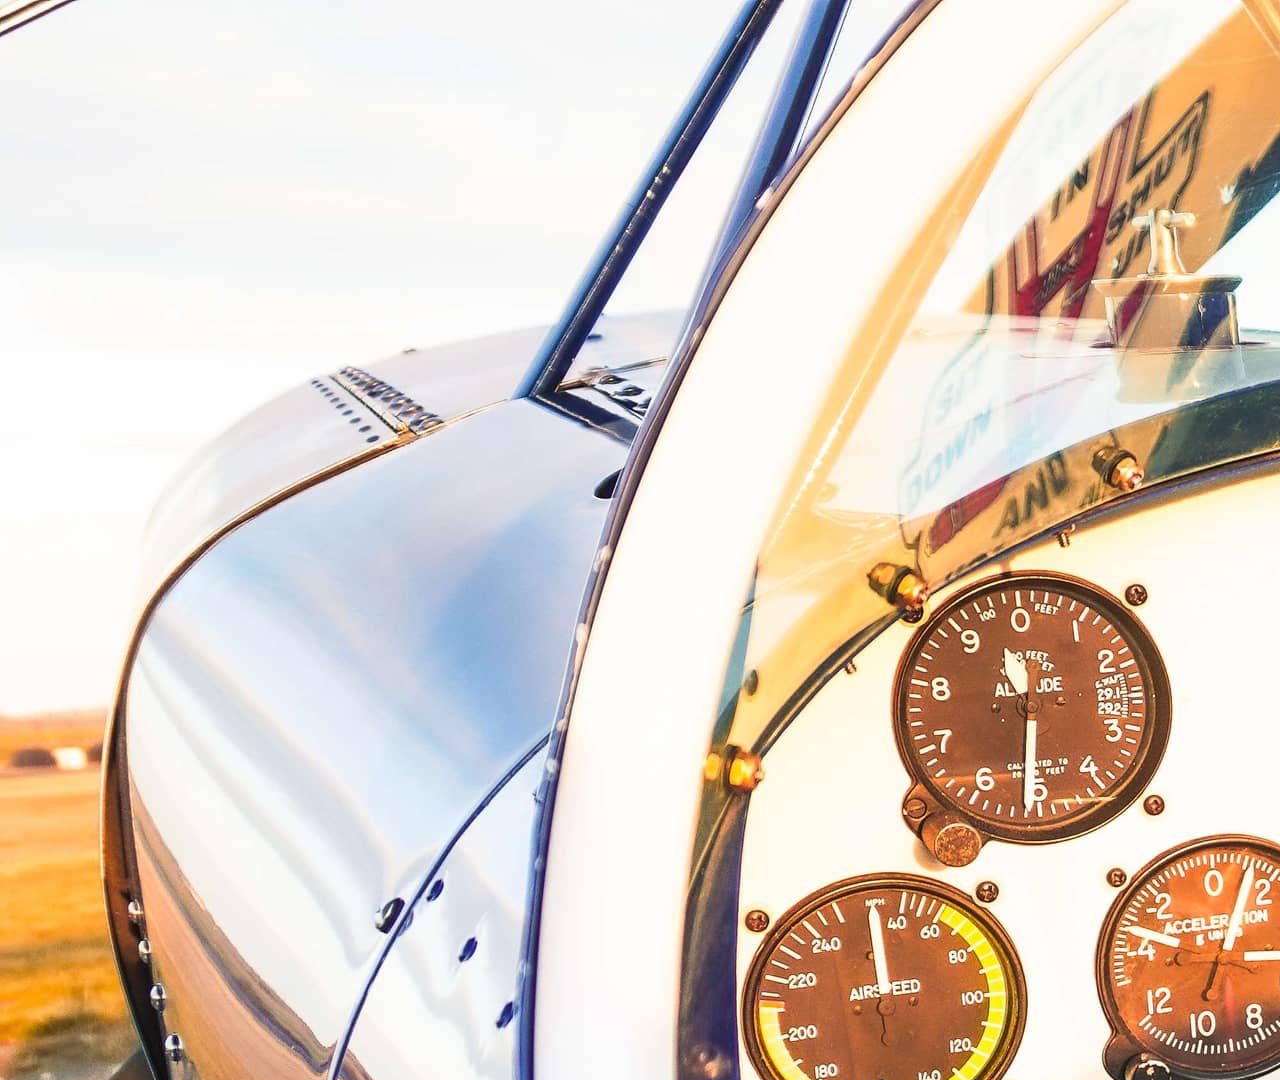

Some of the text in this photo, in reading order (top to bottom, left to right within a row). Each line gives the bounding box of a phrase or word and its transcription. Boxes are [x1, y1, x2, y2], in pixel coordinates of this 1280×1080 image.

[980, 603, 1059, 621] 100 FEET
[1010, 608, 1030, 632] 0
[960, 629, 981, 654] 9
[1072, 620, 1080, 643] 1
[1098, 649, 1116, 673] 2
[931, 677, 951, 701] 8
[994, 676, 1064, 697] ALUDE
[933, 729, 952, 754] 7
[1103, 718, 1123, 743] 3
[1007, 759, 1053, 771] CALATED
[1045, 766, 1065, 775] FEET
[1079, 755, 1099, 777] 4
[975, 767, 995, 791] 6
[1204, 869, 1224, 897] 0
[1254, 878, 1273, 906] 2
[887, 916, 907, 930] 40
[920, 924, 940, 939] 60
[1164, 909, 1269, 936] ACCELERION
[811, 937, 841, 954] 240
[948, 950, 967, 964] 80
[788, 973, 817, 990] 220
[961, 990, 984, 1005] 100
[1147, 986, 1173, 1015] 12
[1189, 1010, 1217, 1038] 10
[1245, 1003, 1263, 1029] 8
[788, 1024, 817, 1042] 200
[949, 1038, 972, 1054] 120
[814, 1063, 838, 1079] 180
